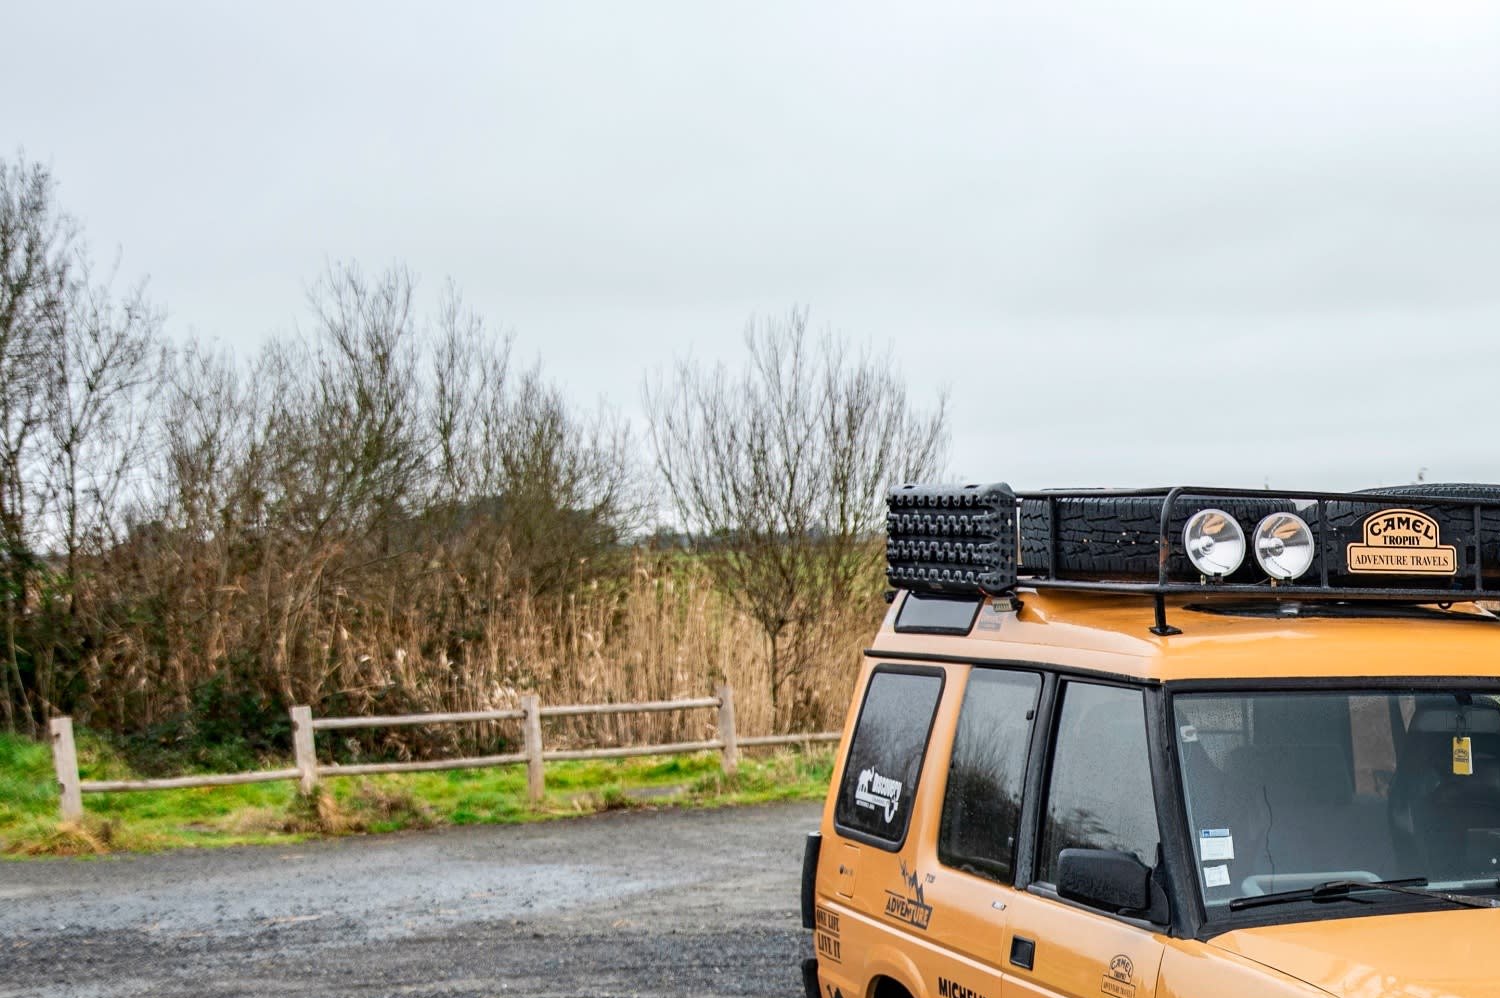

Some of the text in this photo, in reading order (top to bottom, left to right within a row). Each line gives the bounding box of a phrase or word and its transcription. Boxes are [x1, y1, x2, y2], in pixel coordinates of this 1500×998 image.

[1369, 516, 1434, 540] CAMEL
[1383, 534, 1421, 546] TROPHY
[1355, 554, 1449, 567] ADVENTURE TRAVELS
[886, 896, 929, 926] ADVENTURE
[818, 932, 832, 955] LIVE
[1110, 958, 1132, 978] CAMEL
